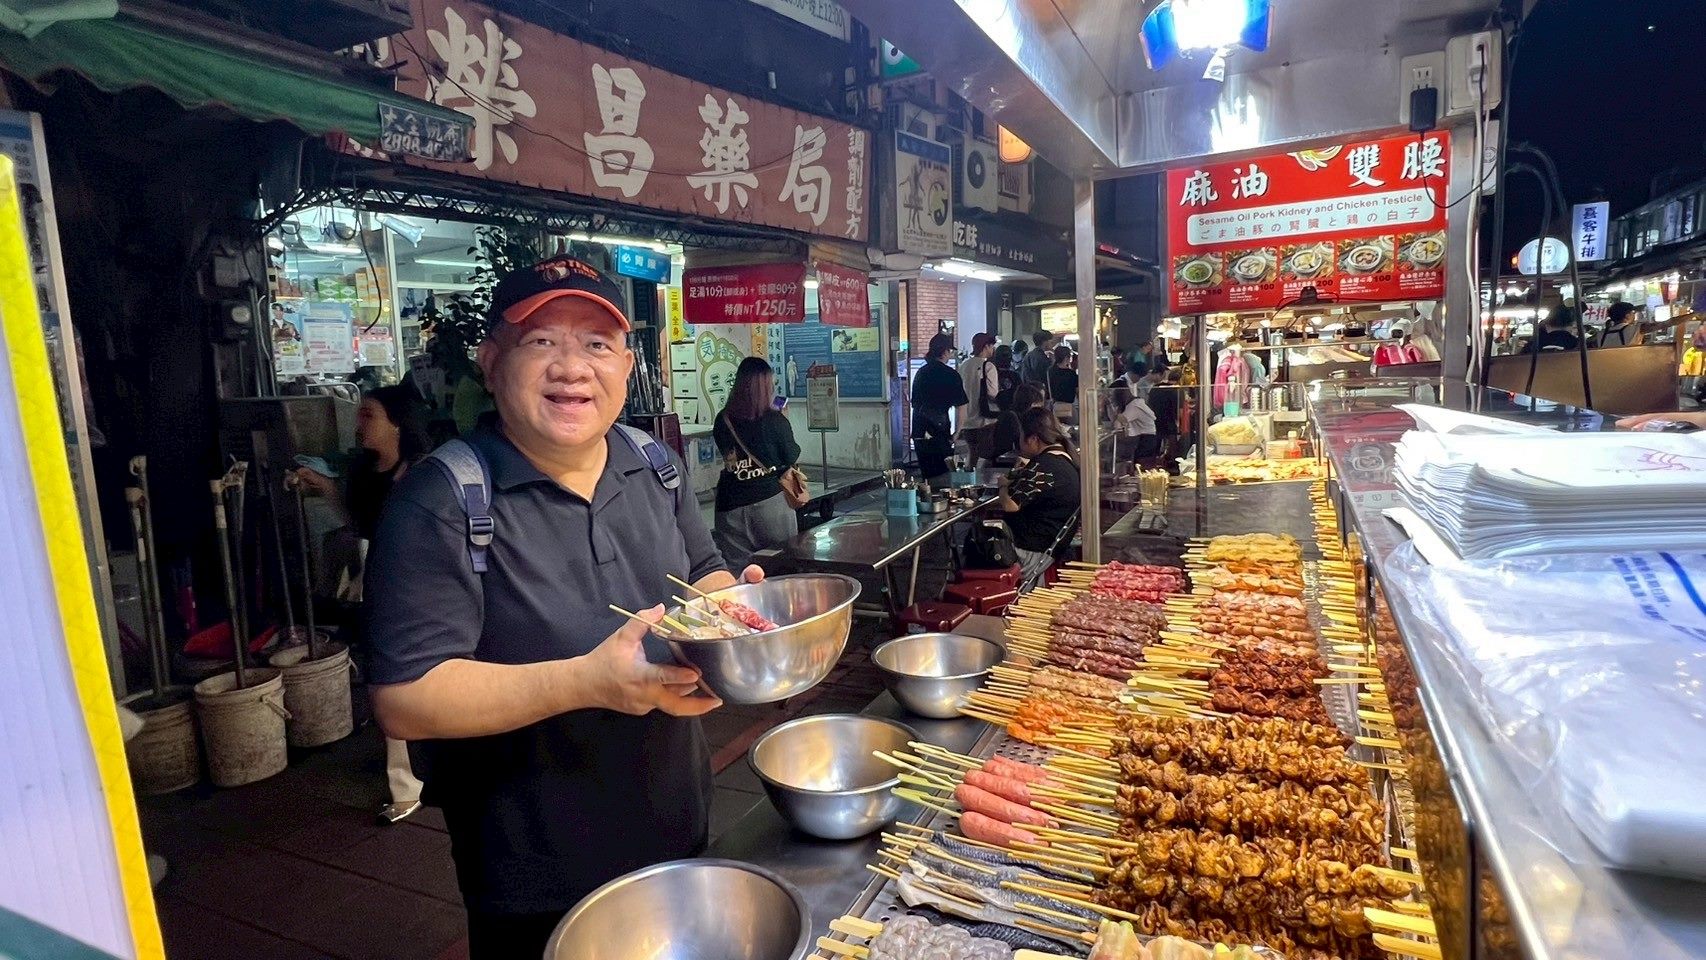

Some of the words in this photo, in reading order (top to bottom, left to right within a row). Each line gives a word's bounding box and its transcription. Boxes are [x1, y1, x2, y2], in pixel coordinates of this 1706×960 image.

[426, 6, 833, 227] 榮昌藥局
[845, 128, 866, 239] 調劑配方
[1179, 163, 1271, 207] 麻油
[1345, 137, 1447, 188] 雙腰
[1199, 216, 1234, 226] Sesame
[1237, 214, 1250, 222] Oil
[1253, 210, 1275, 220] Pork
[1278, 207, 1313, 217] Kidney
[1314, 204, 1333, 214] and
[1336, 200, 1379, 210] Chicken
[1381, 194, 1423, 205] Testicle
[1317, 279, 1334, 287] 200
[1373, 274, 1391, 282] 100
